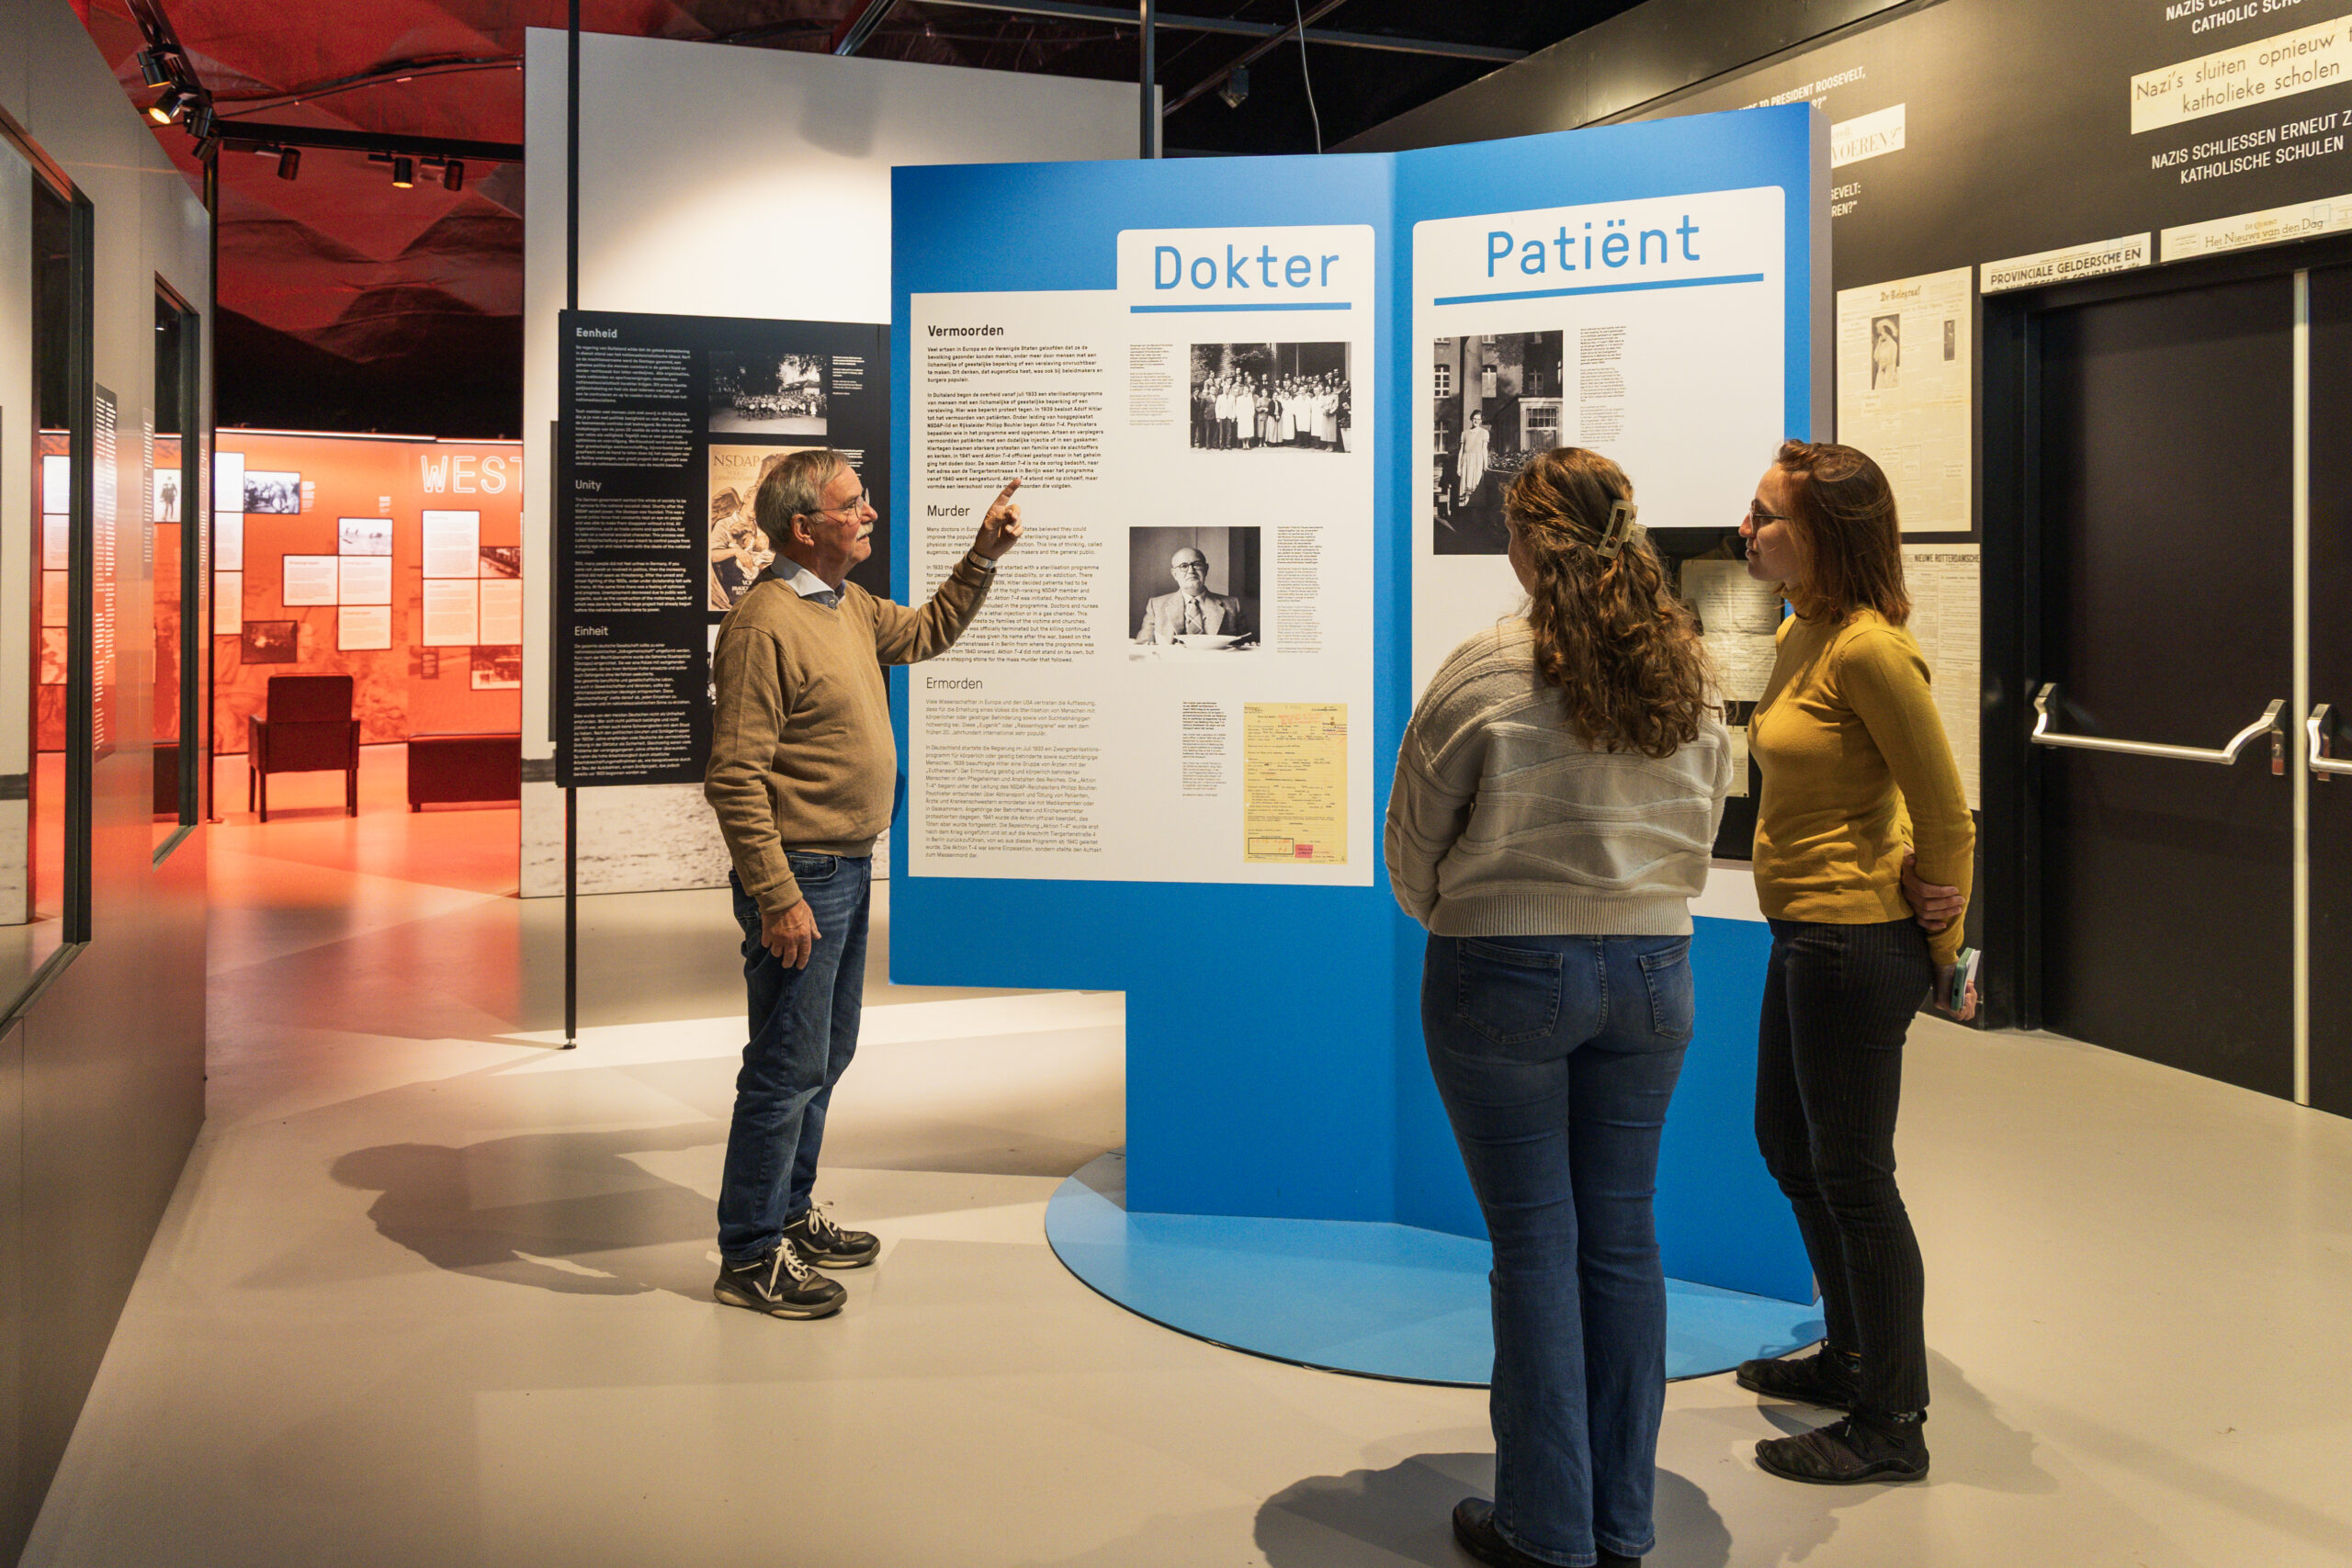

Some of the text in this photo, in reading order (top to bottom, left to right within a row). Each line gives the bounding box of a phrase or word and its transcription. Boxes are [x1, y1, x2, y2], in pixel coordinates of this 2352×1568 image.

[2166, 0, 2204, 21] NAZIS
[2192, 4, 2258, 34] CATHOLIC
[2196, 61, 2246, 84] sluiten
[2259, 35, 2335, 67] opnieuw
[1771, 83, 1814, 106] PRESIDENT
[1816, 66, 1866, 93] ROOSEVELT,
[2183, 60, 2340, 113] katholieke scholen
[2152, 149, 2188, 169] NAZIS
[2192, 128, 2276, 160] SCHLIESSEN
[2281, 113, 2338, 140] ERNEUT
[2181, 135, 2344, 184] KATHOLISCHE SCHULEN
[1487, 214, 1700, 278] Patiënt
[2205, 236, 2222, 248] Het
[2225, 232, 2260, 244] Nieuws
[2262, 229, 2280, 238] van
[2282, 223, 2300, 234] den
[2302, 218, 2324, 230] Dag
[1155, 244, 1340, 290] Dokter
[1990, 265, 2053, 285] PROVINCIALE
[2057, 252, 2121, 273] GELDERSCHE
[2125, 247, 2141, 261] EN
[576, 328, 618, 338] Eenheid
[928, 325, 1004, 336] Vermoorden
[714, 455, 760, 467] NSDAP
[575, 480, 602, 491] Unity
[927, 505, 970, 516] Murder
[574, 626, 609, 636] Einheit
[926, 677, 983, 689] Ermorden
